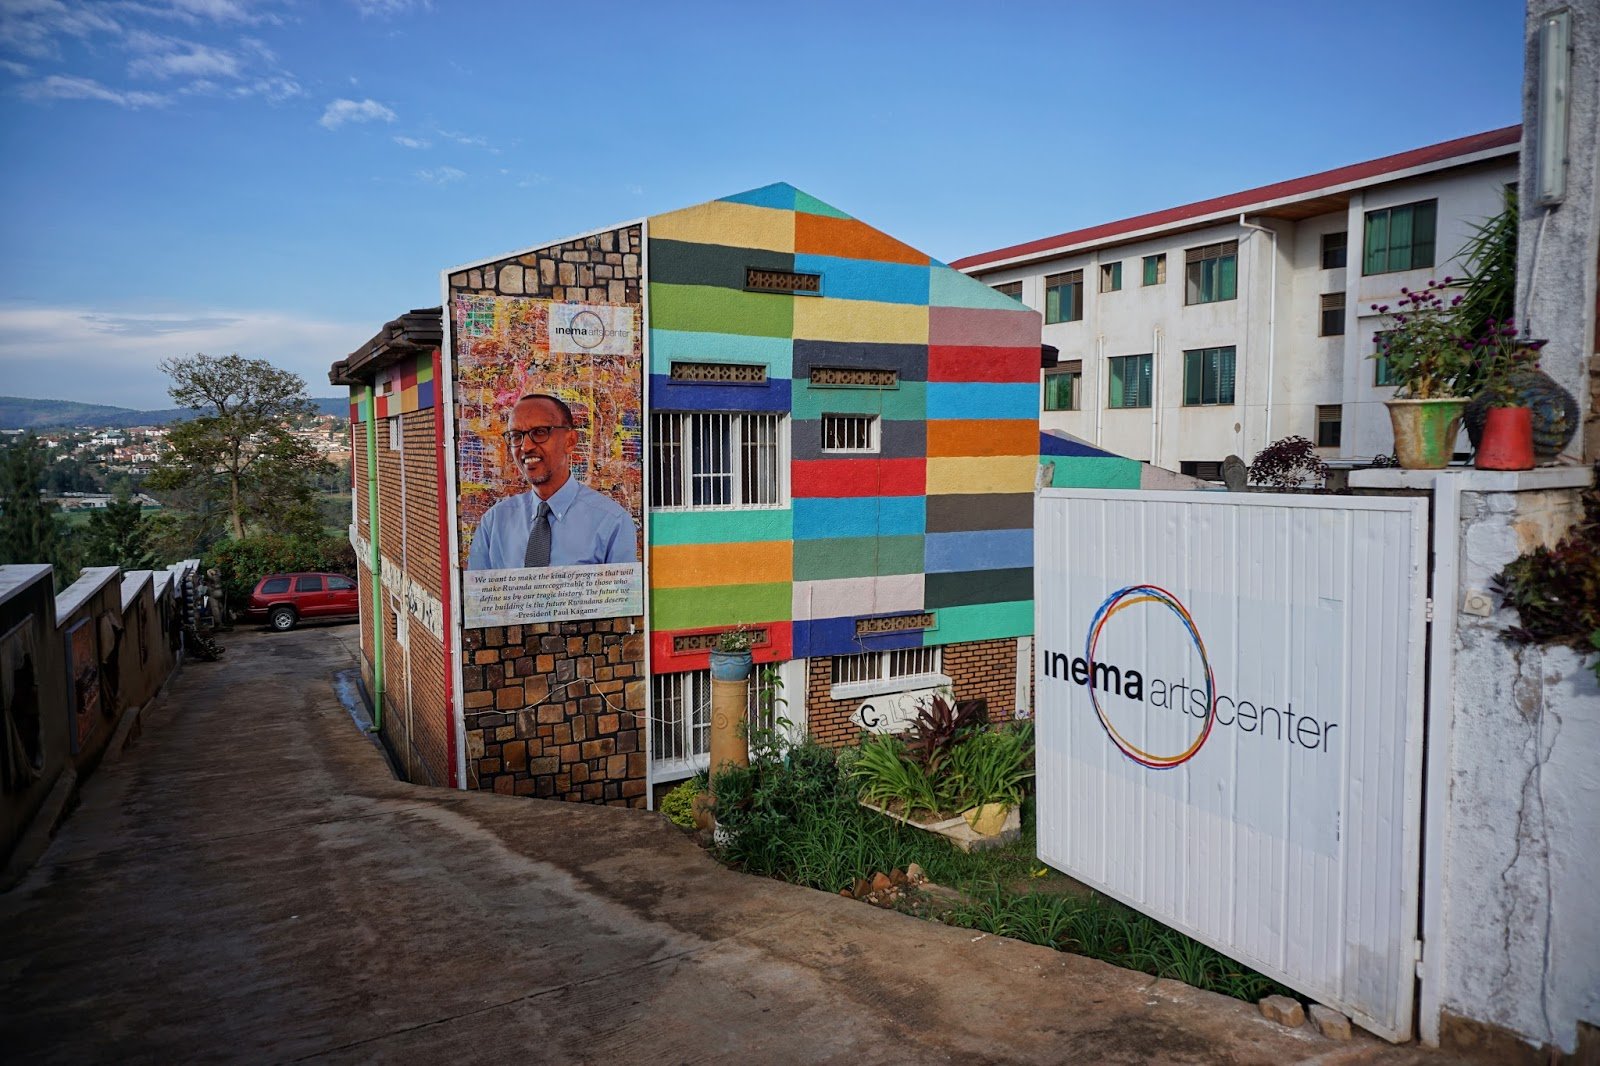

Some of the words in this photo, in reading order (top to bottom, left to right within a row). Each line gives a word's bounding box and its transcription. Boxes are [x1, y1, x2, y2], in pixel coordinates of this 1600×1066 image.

[555, 327, 587, 336] inema
[568, 572, 574, 580] of
[503, 584, 532, 592] Rwanda
[534, 581, 584, 590] unrecognizable
[537, 592, 556, 600] tragic
[545, 601, 566, 609] future
[568, 598, 603, 606] Rwandans
[1044, 650, 1144, 701] inema
[1150, 677, 1207, 719] arts
[1214, 695, 1338, 752] center
